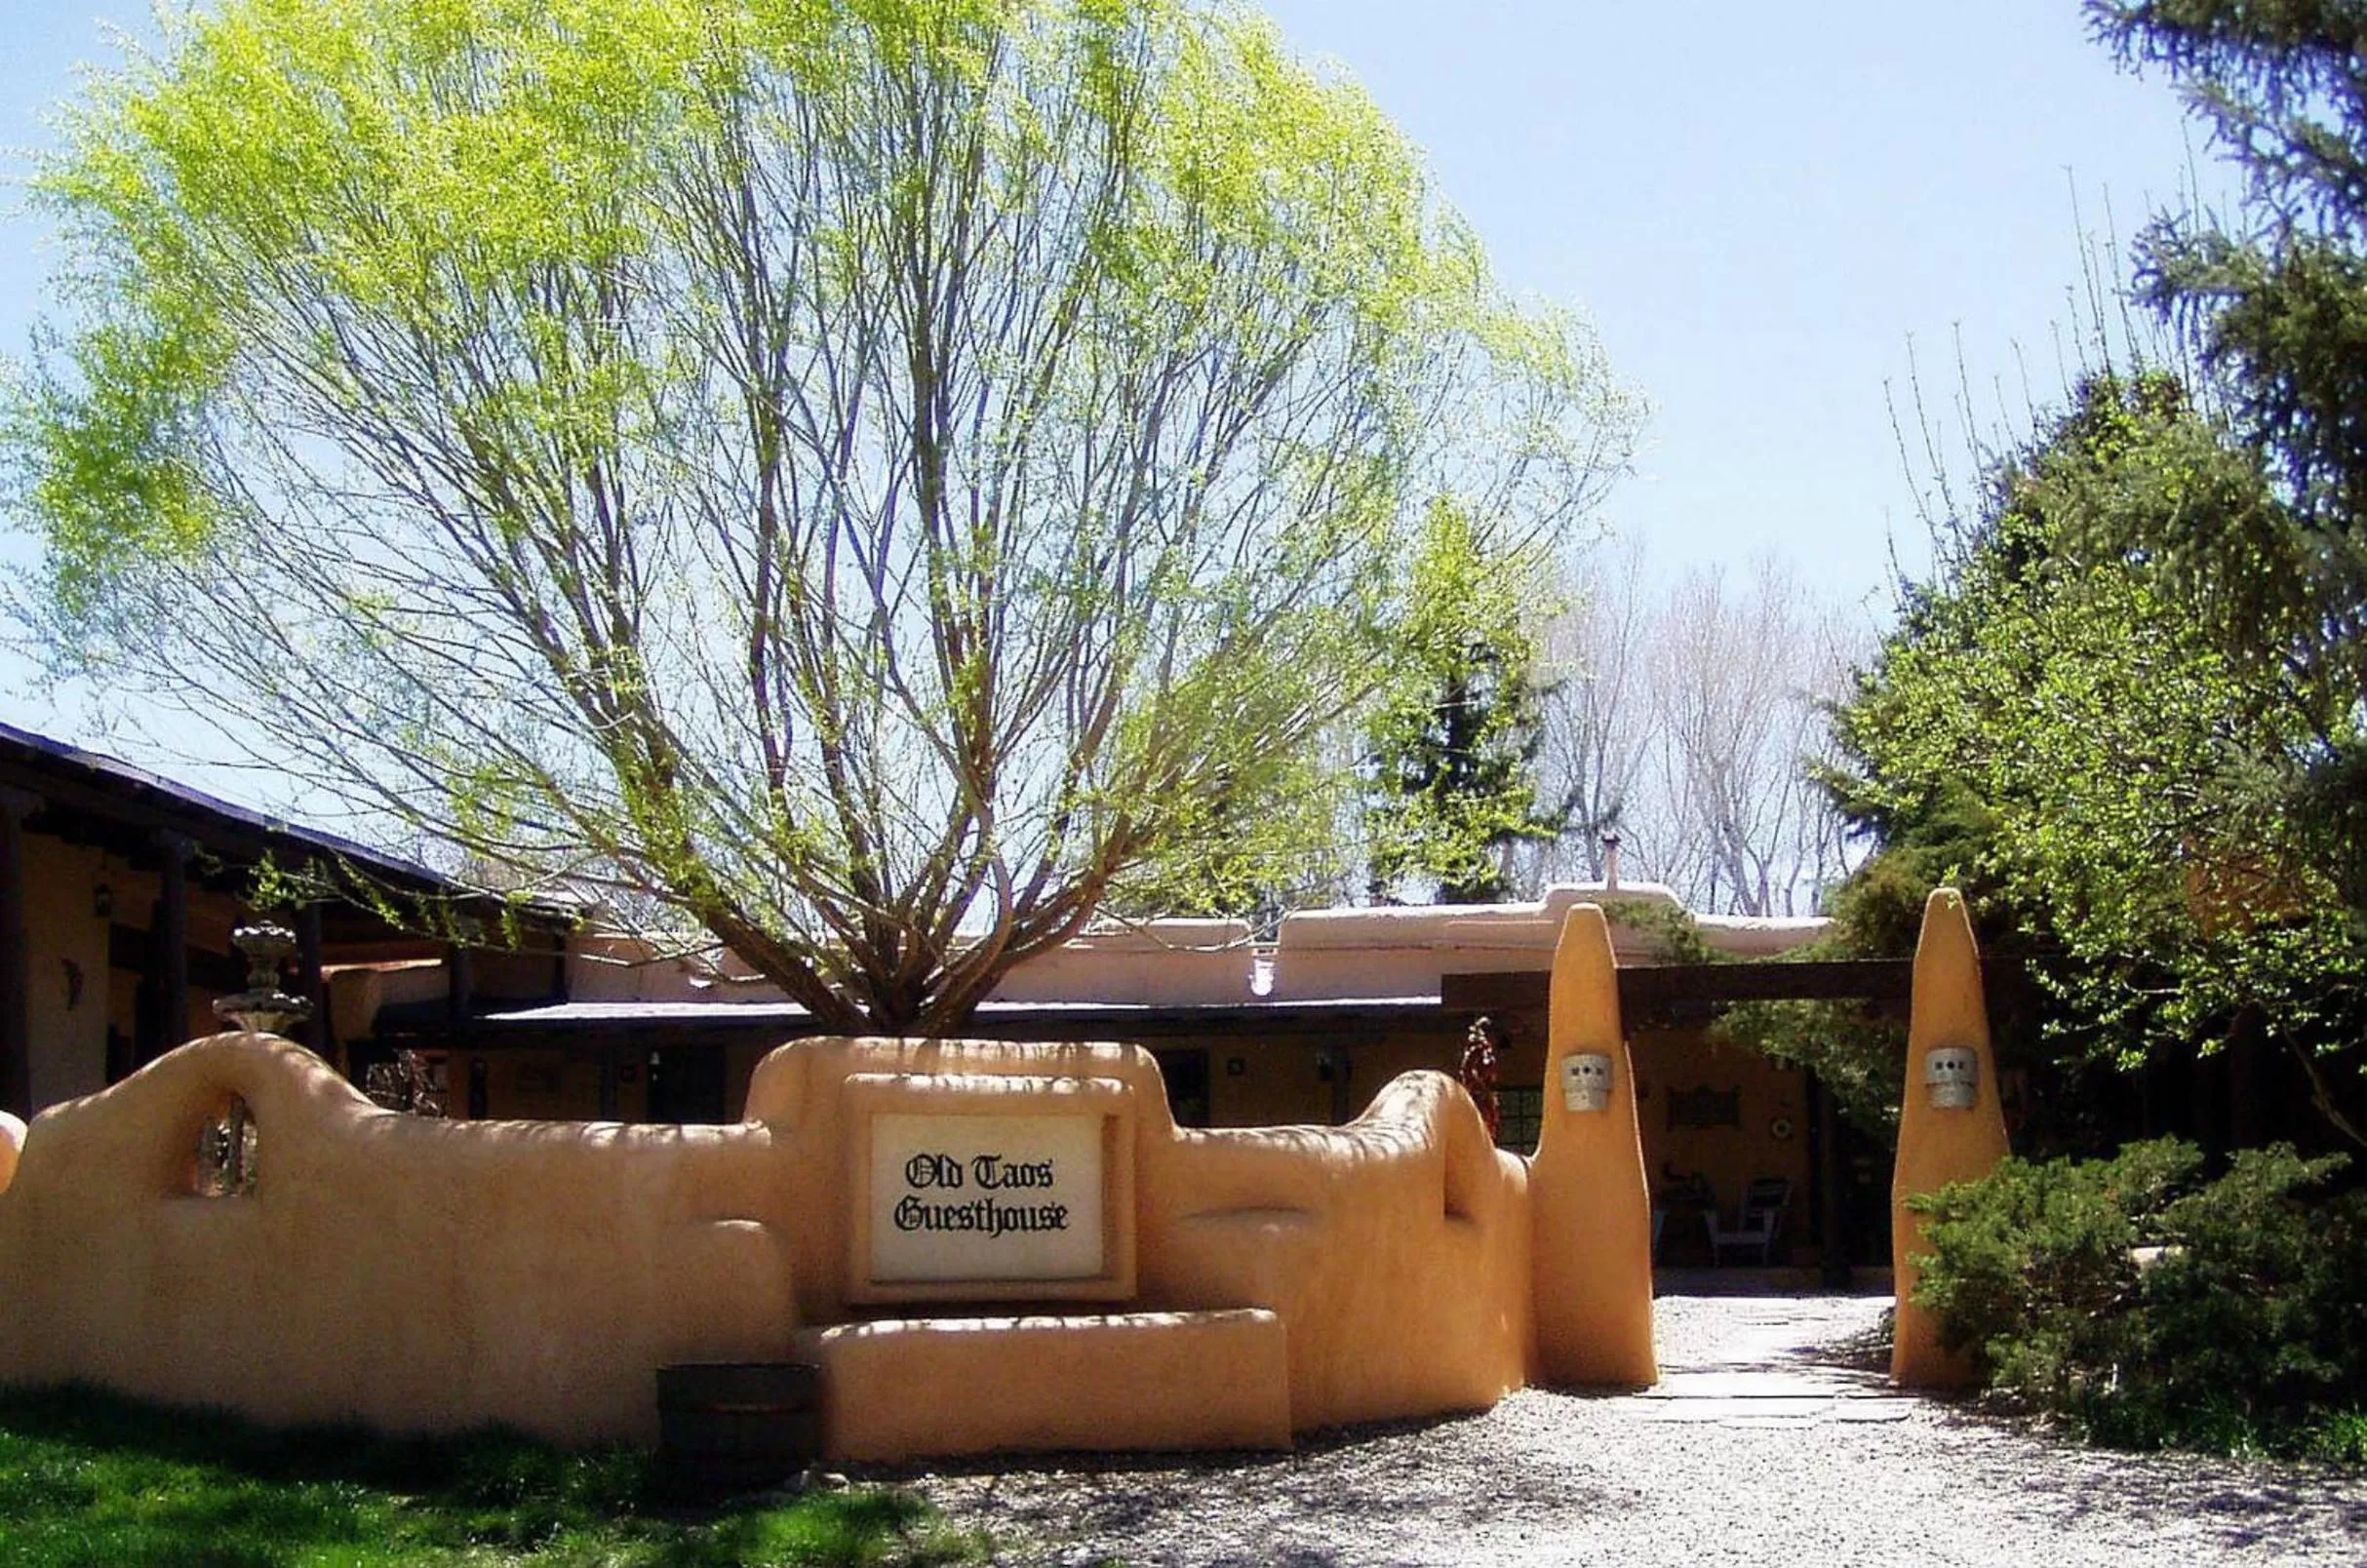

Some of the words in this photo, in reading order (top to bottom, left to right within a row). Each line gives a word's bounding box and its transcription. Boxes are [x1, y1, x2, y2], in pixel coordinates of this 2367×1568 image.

[904, 1153, 965, 1190] Old
[970, 1154, 1054, 1191] Taos
[893, 1194, 1070, 1239] Guesthouse
